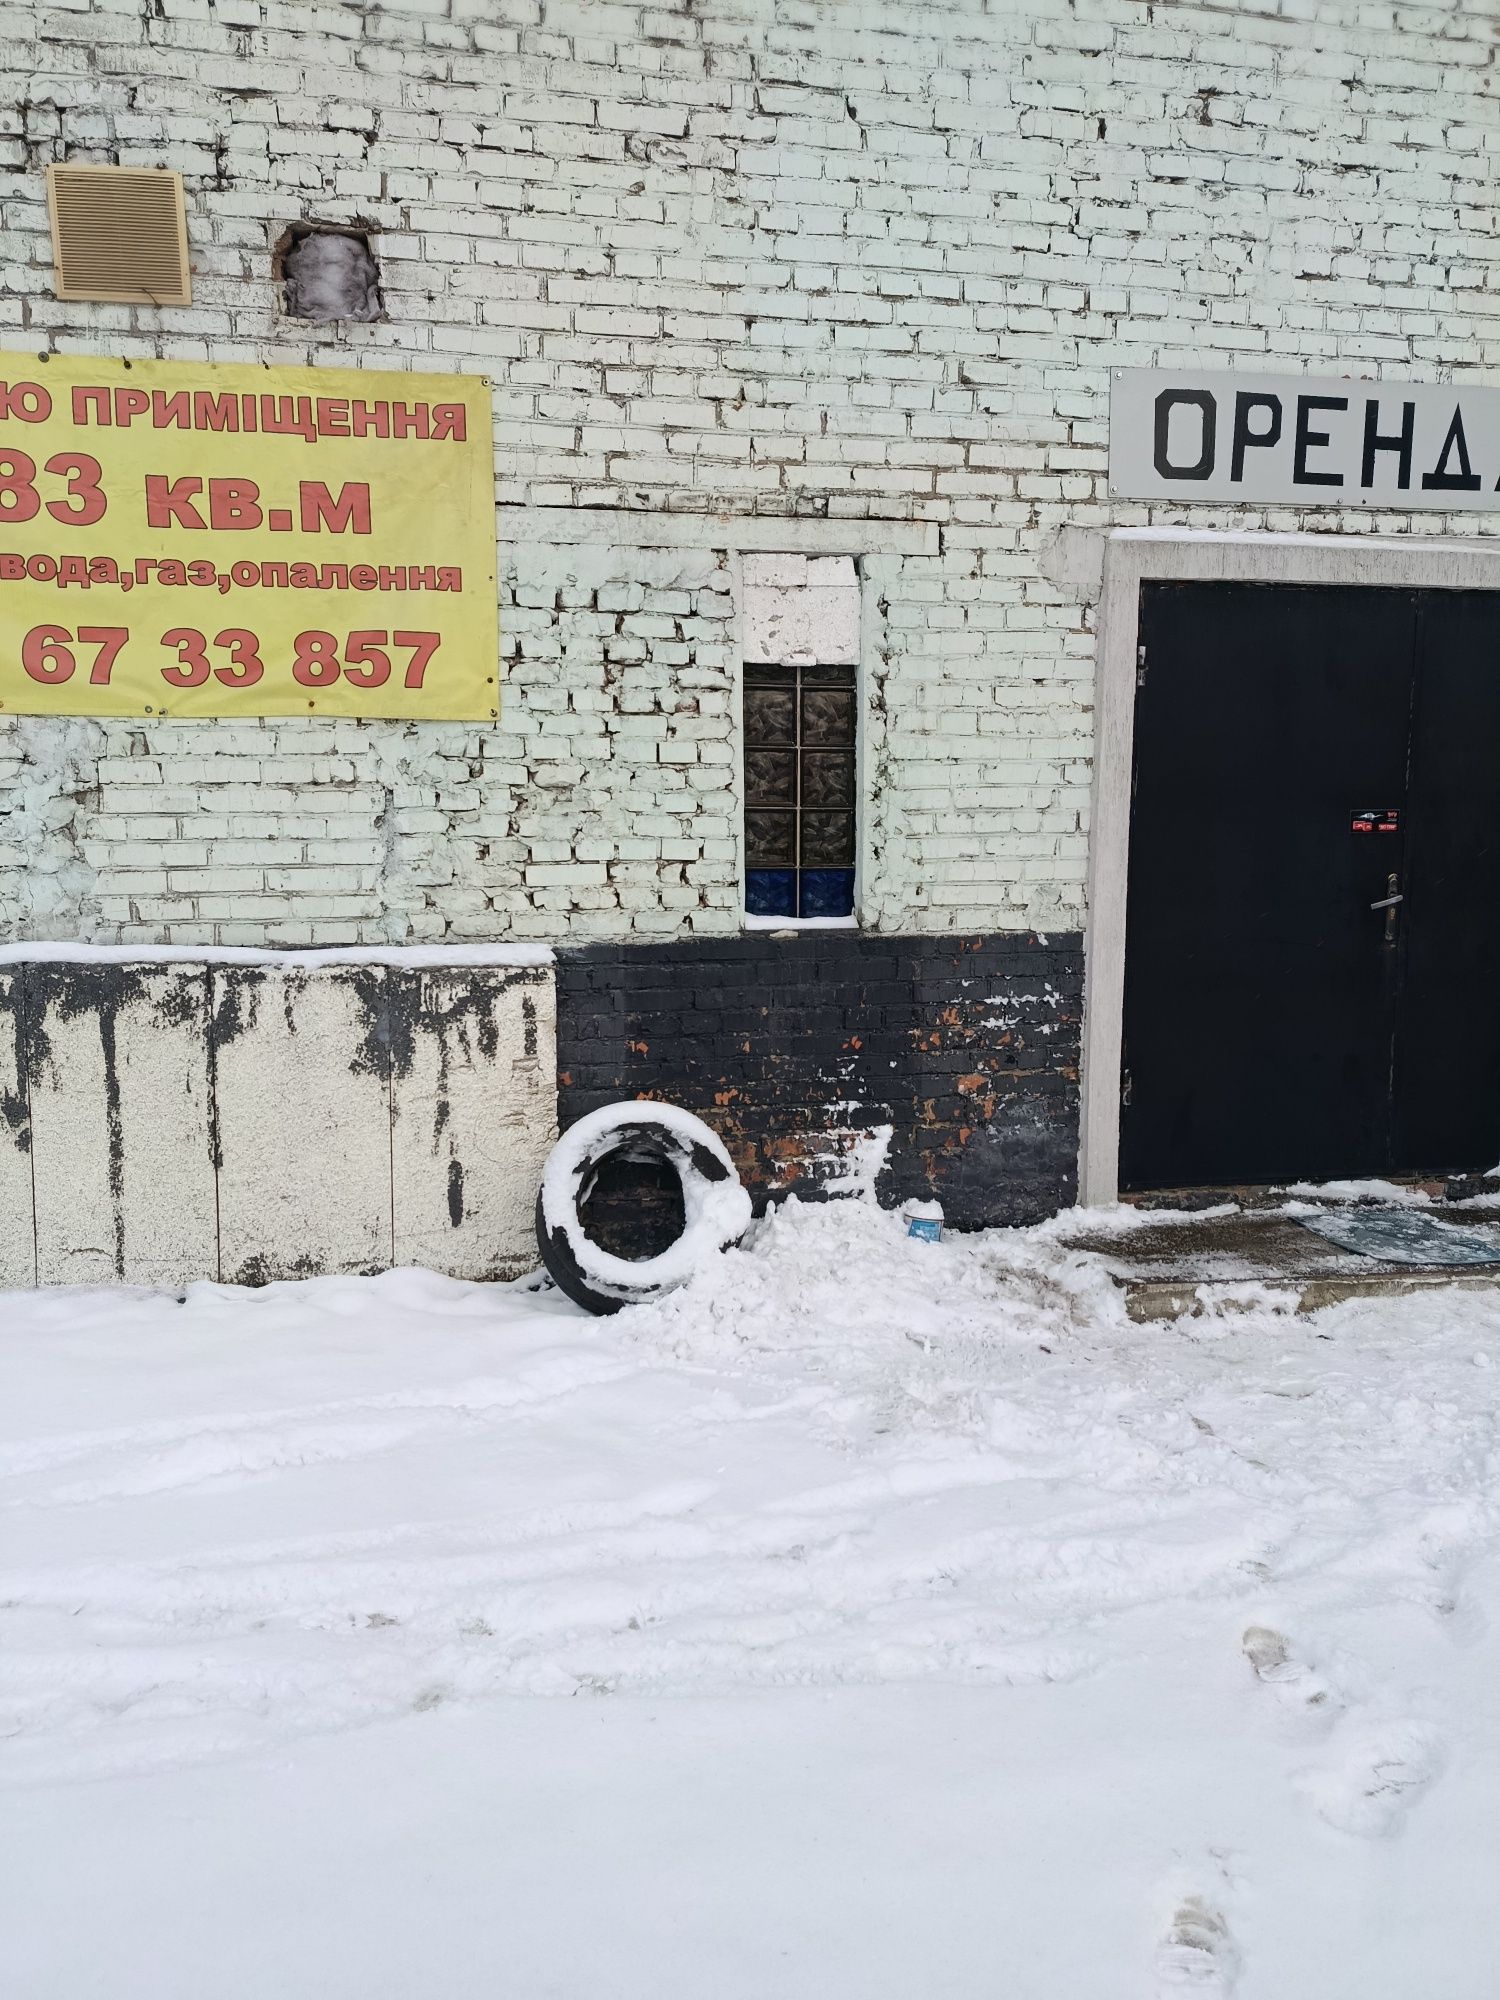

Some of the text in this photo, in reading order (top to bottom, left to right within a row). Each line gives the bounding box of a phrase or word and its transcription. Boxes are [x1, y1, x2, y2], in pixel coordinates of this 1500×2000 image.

[71, 385, 469, 444] ПРИМІЩЕННЯ
[1153, 388, 1500, 492] ОРЕНД
[0, 553, 464, 595] вода,газ,опалення
[22, 624, 442, 689] 67 33 857
